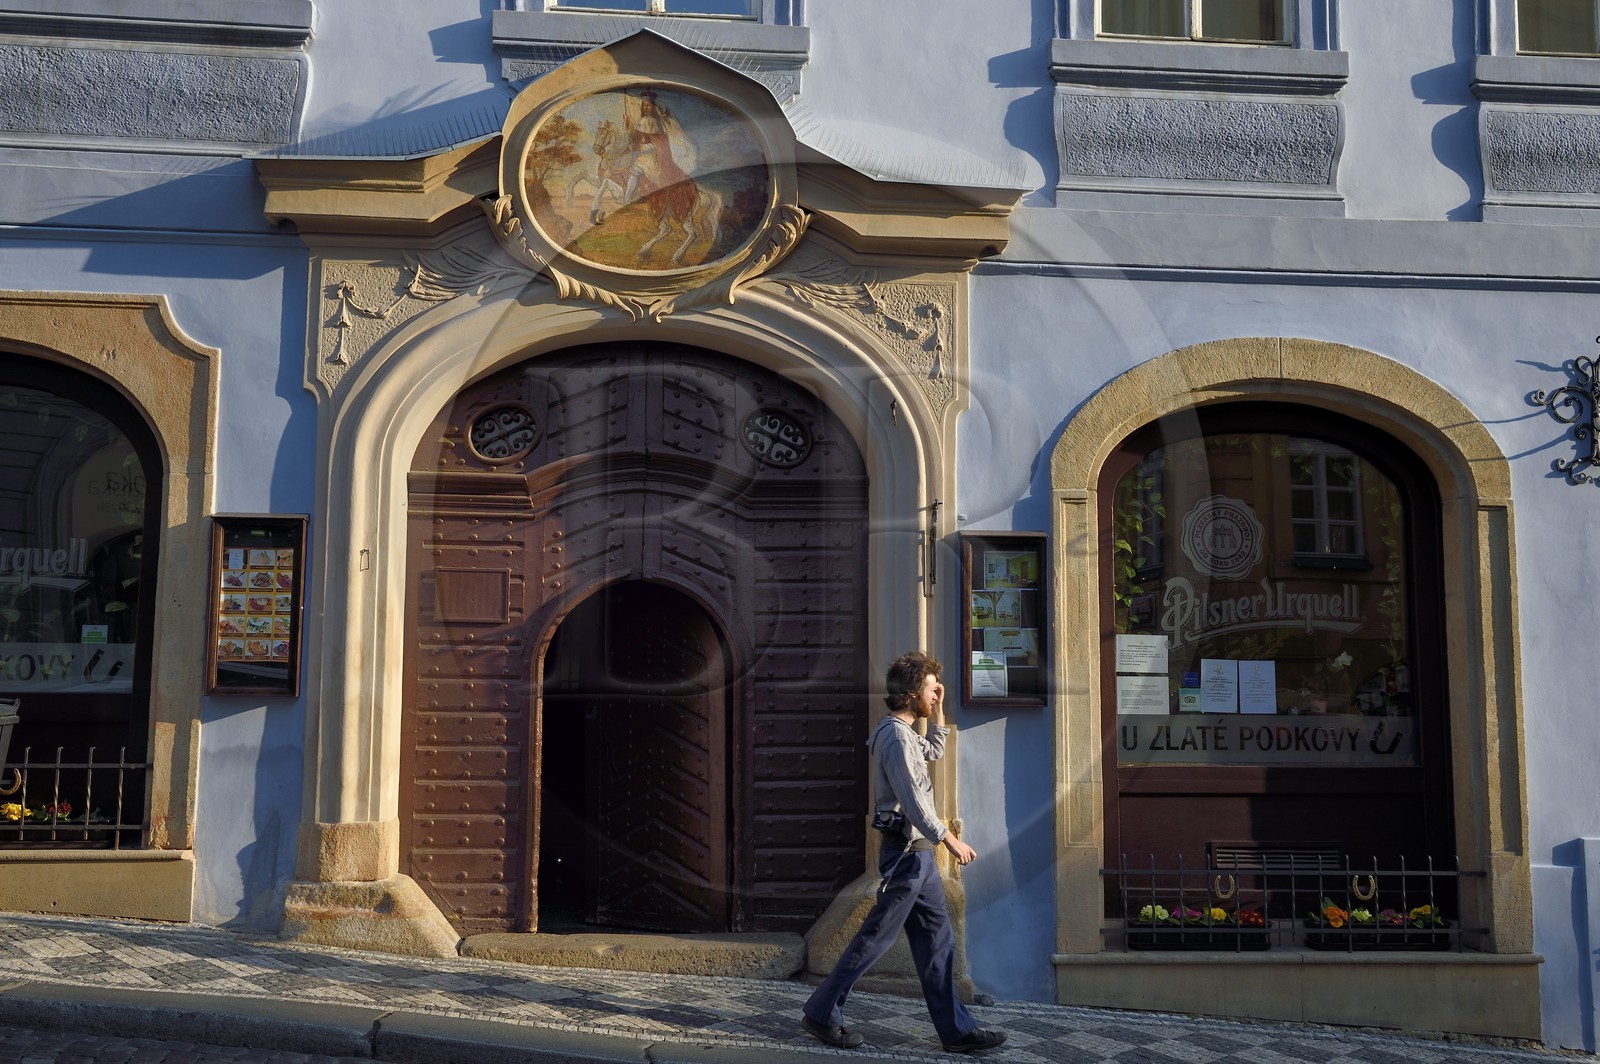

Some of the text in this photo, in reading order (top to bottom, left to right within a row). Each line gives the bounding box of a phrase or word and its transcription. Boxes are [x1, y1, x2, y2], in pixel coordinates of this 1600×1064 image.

[1224, 510, 1251, 541] PRAZDROJ
[1200, 549, 1209, 559] OD
[1209, 558, 1229, 567] ROKU
[1160, 576, 1361, 651] Pilsner Urquell
[1121, 719, 1361, 751] U ZLATÉ PODKOVY
